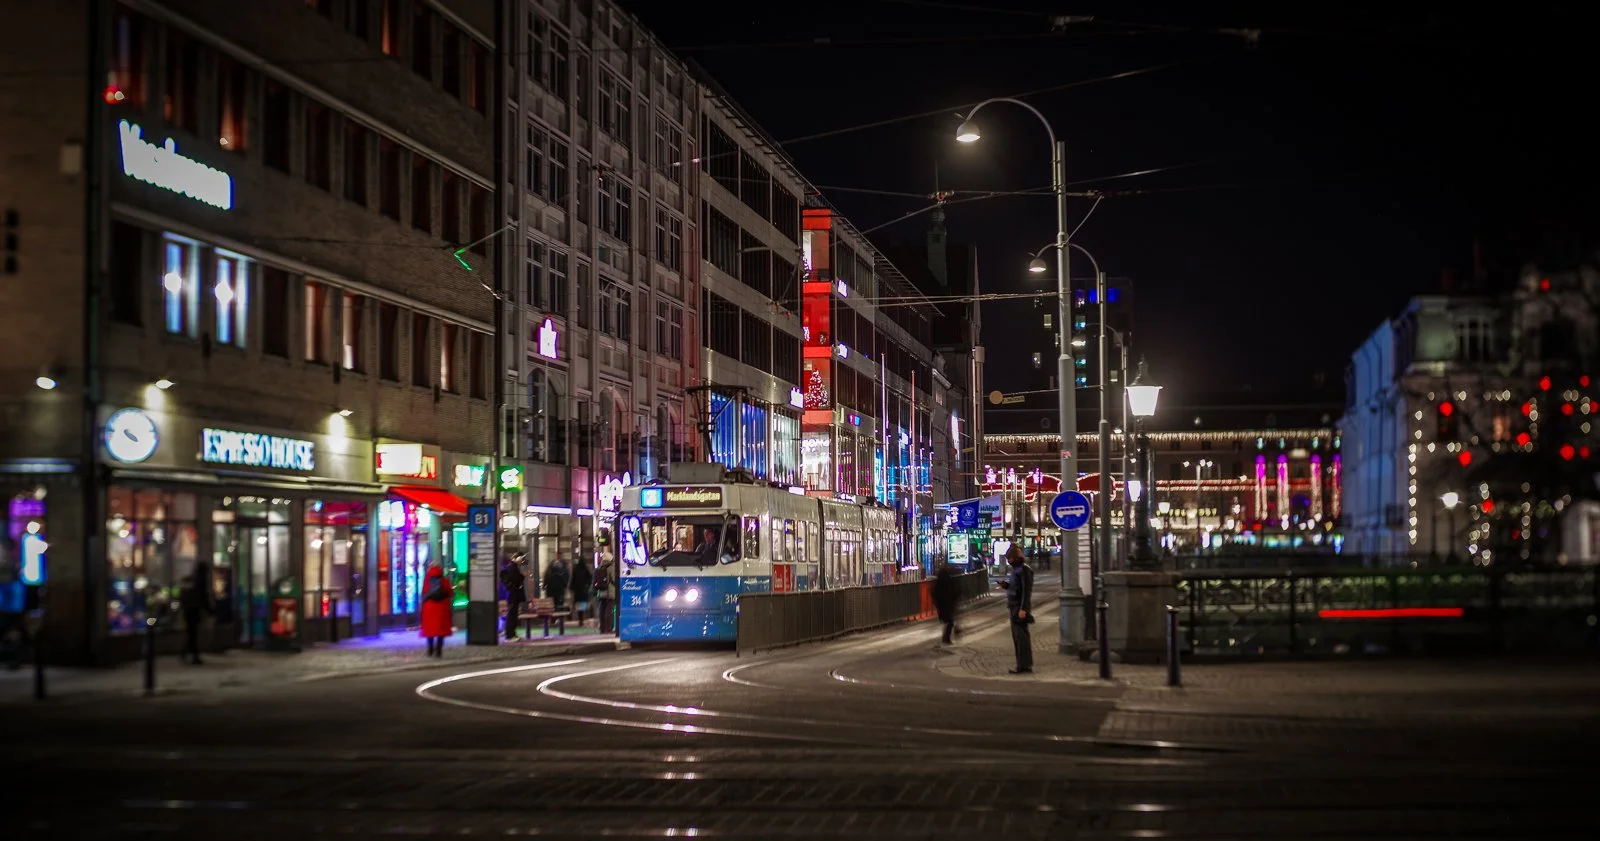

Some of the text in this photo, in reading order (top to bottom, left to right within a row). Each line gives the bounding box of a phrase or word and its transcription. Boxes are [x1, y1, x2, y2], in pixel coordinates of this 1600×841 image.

[203, 428, 315, 471] ESPRESSO HOUSE
[667, 491, 721, 503] Marklandsgatan
[631, 595, 642, 606] 314
[725, 593, 738, 604] 314
